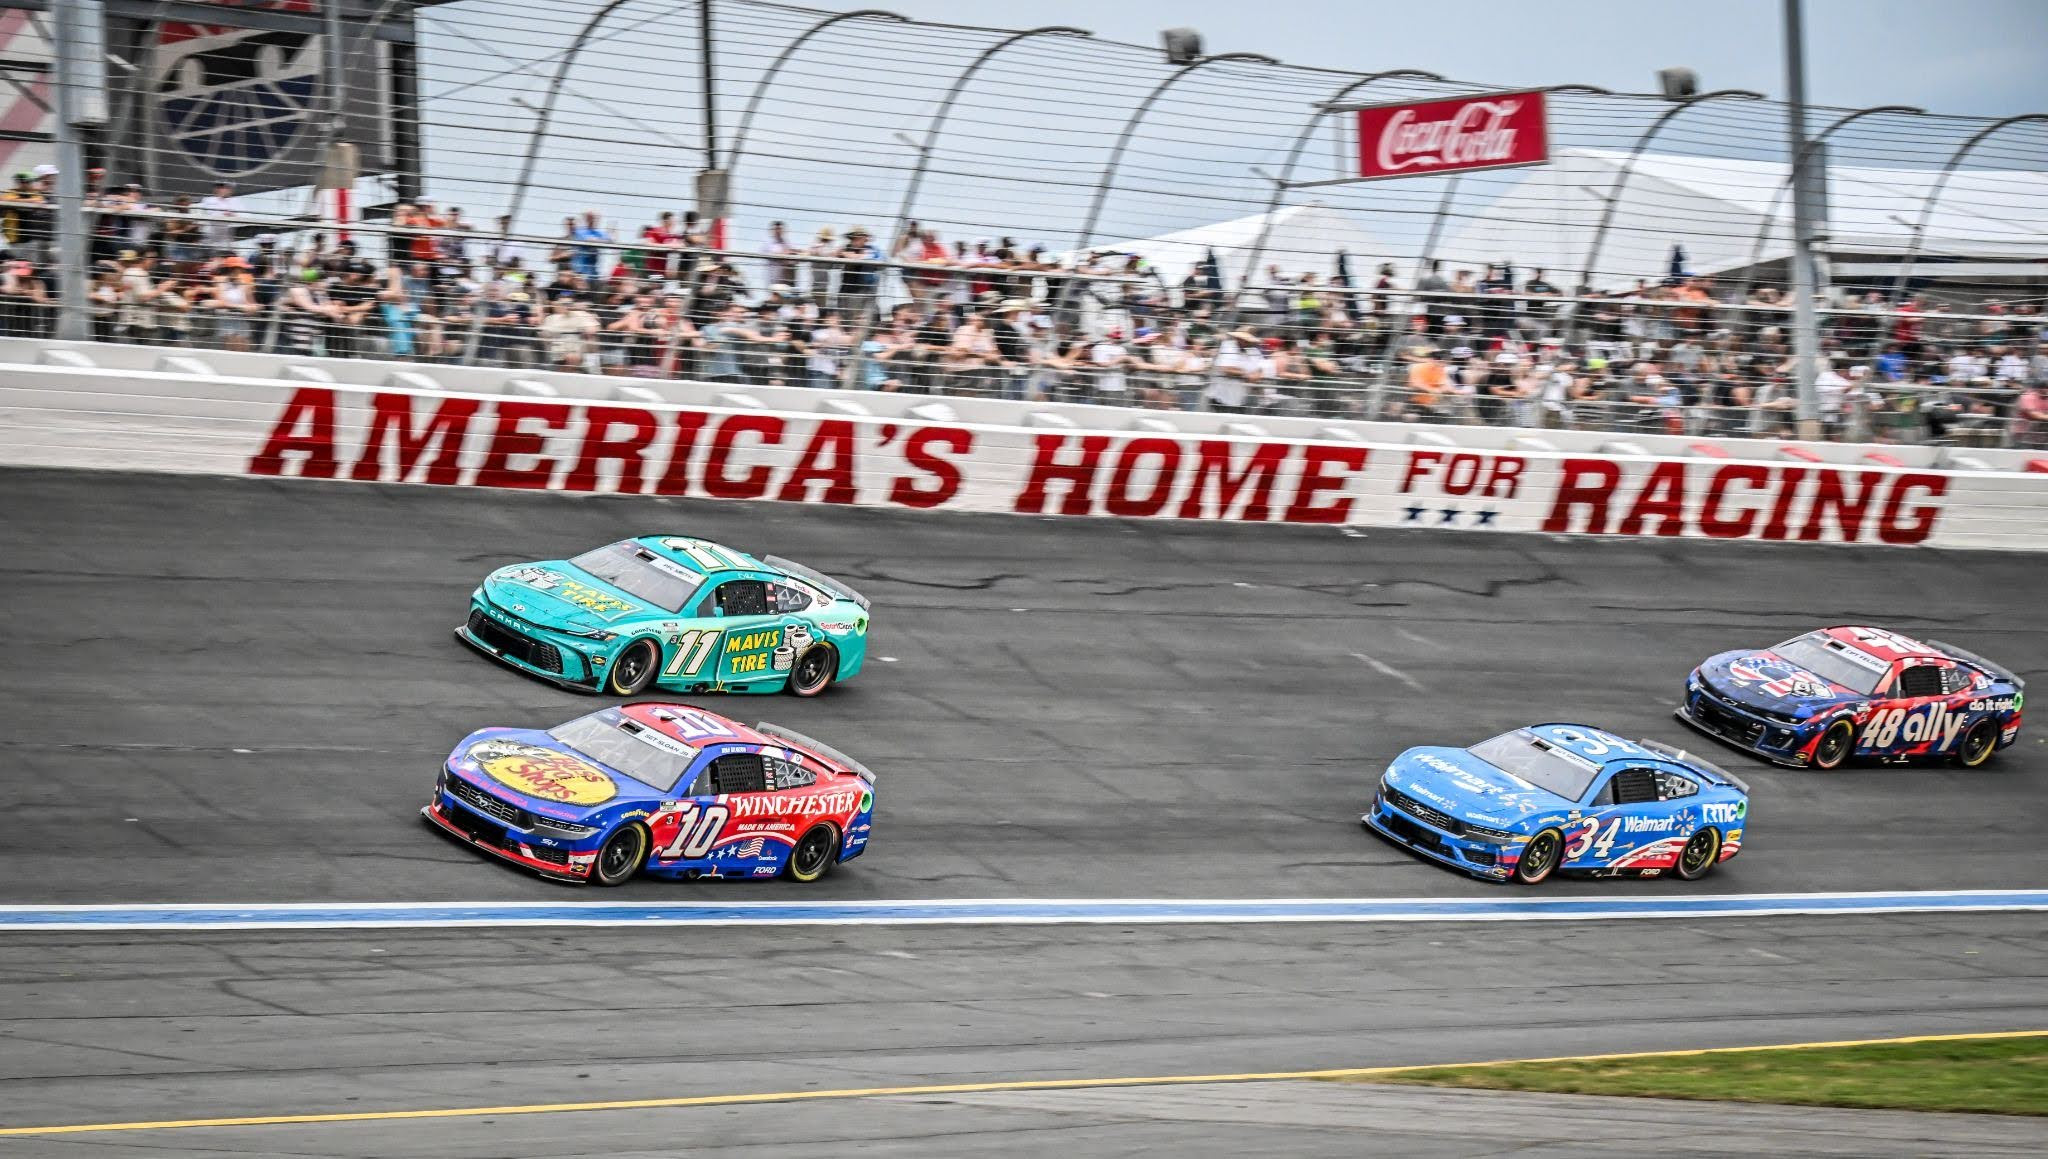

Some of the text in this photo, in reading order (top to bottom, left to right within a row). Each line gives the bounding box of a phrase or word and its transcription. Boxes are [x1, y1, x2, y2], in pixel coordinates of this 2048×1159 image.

[249, 387, 1949, 544] AMERICA'S HOME FOR RACING
[489, 609, 531, 634] CAMRY
[662, 629, 723, 677] 11
[726, 630, 780, 654] MAVIS
[731, 652, 769, 674] TIRE
[1969, 699, 1985, 711] do
[1860, 701, 1967, 752] 48 ally
[505, 763, 578, 800] Shops
[1409, 782, 1445, 803] Walmart
[730, 792, 855, 818] WINCHESTER
[736, 823, 796, 832] MADE IN AMERICA
[1465, 811, 1500, 825] Walmart
[1624, 814, 1676, 833] Walmart
[658, 804, 730, 860] 10
[1567, 816, 1622, 858] 34
[752, 866, 777, 875] FORD
[1640, 868, 1661, 876] FORD
